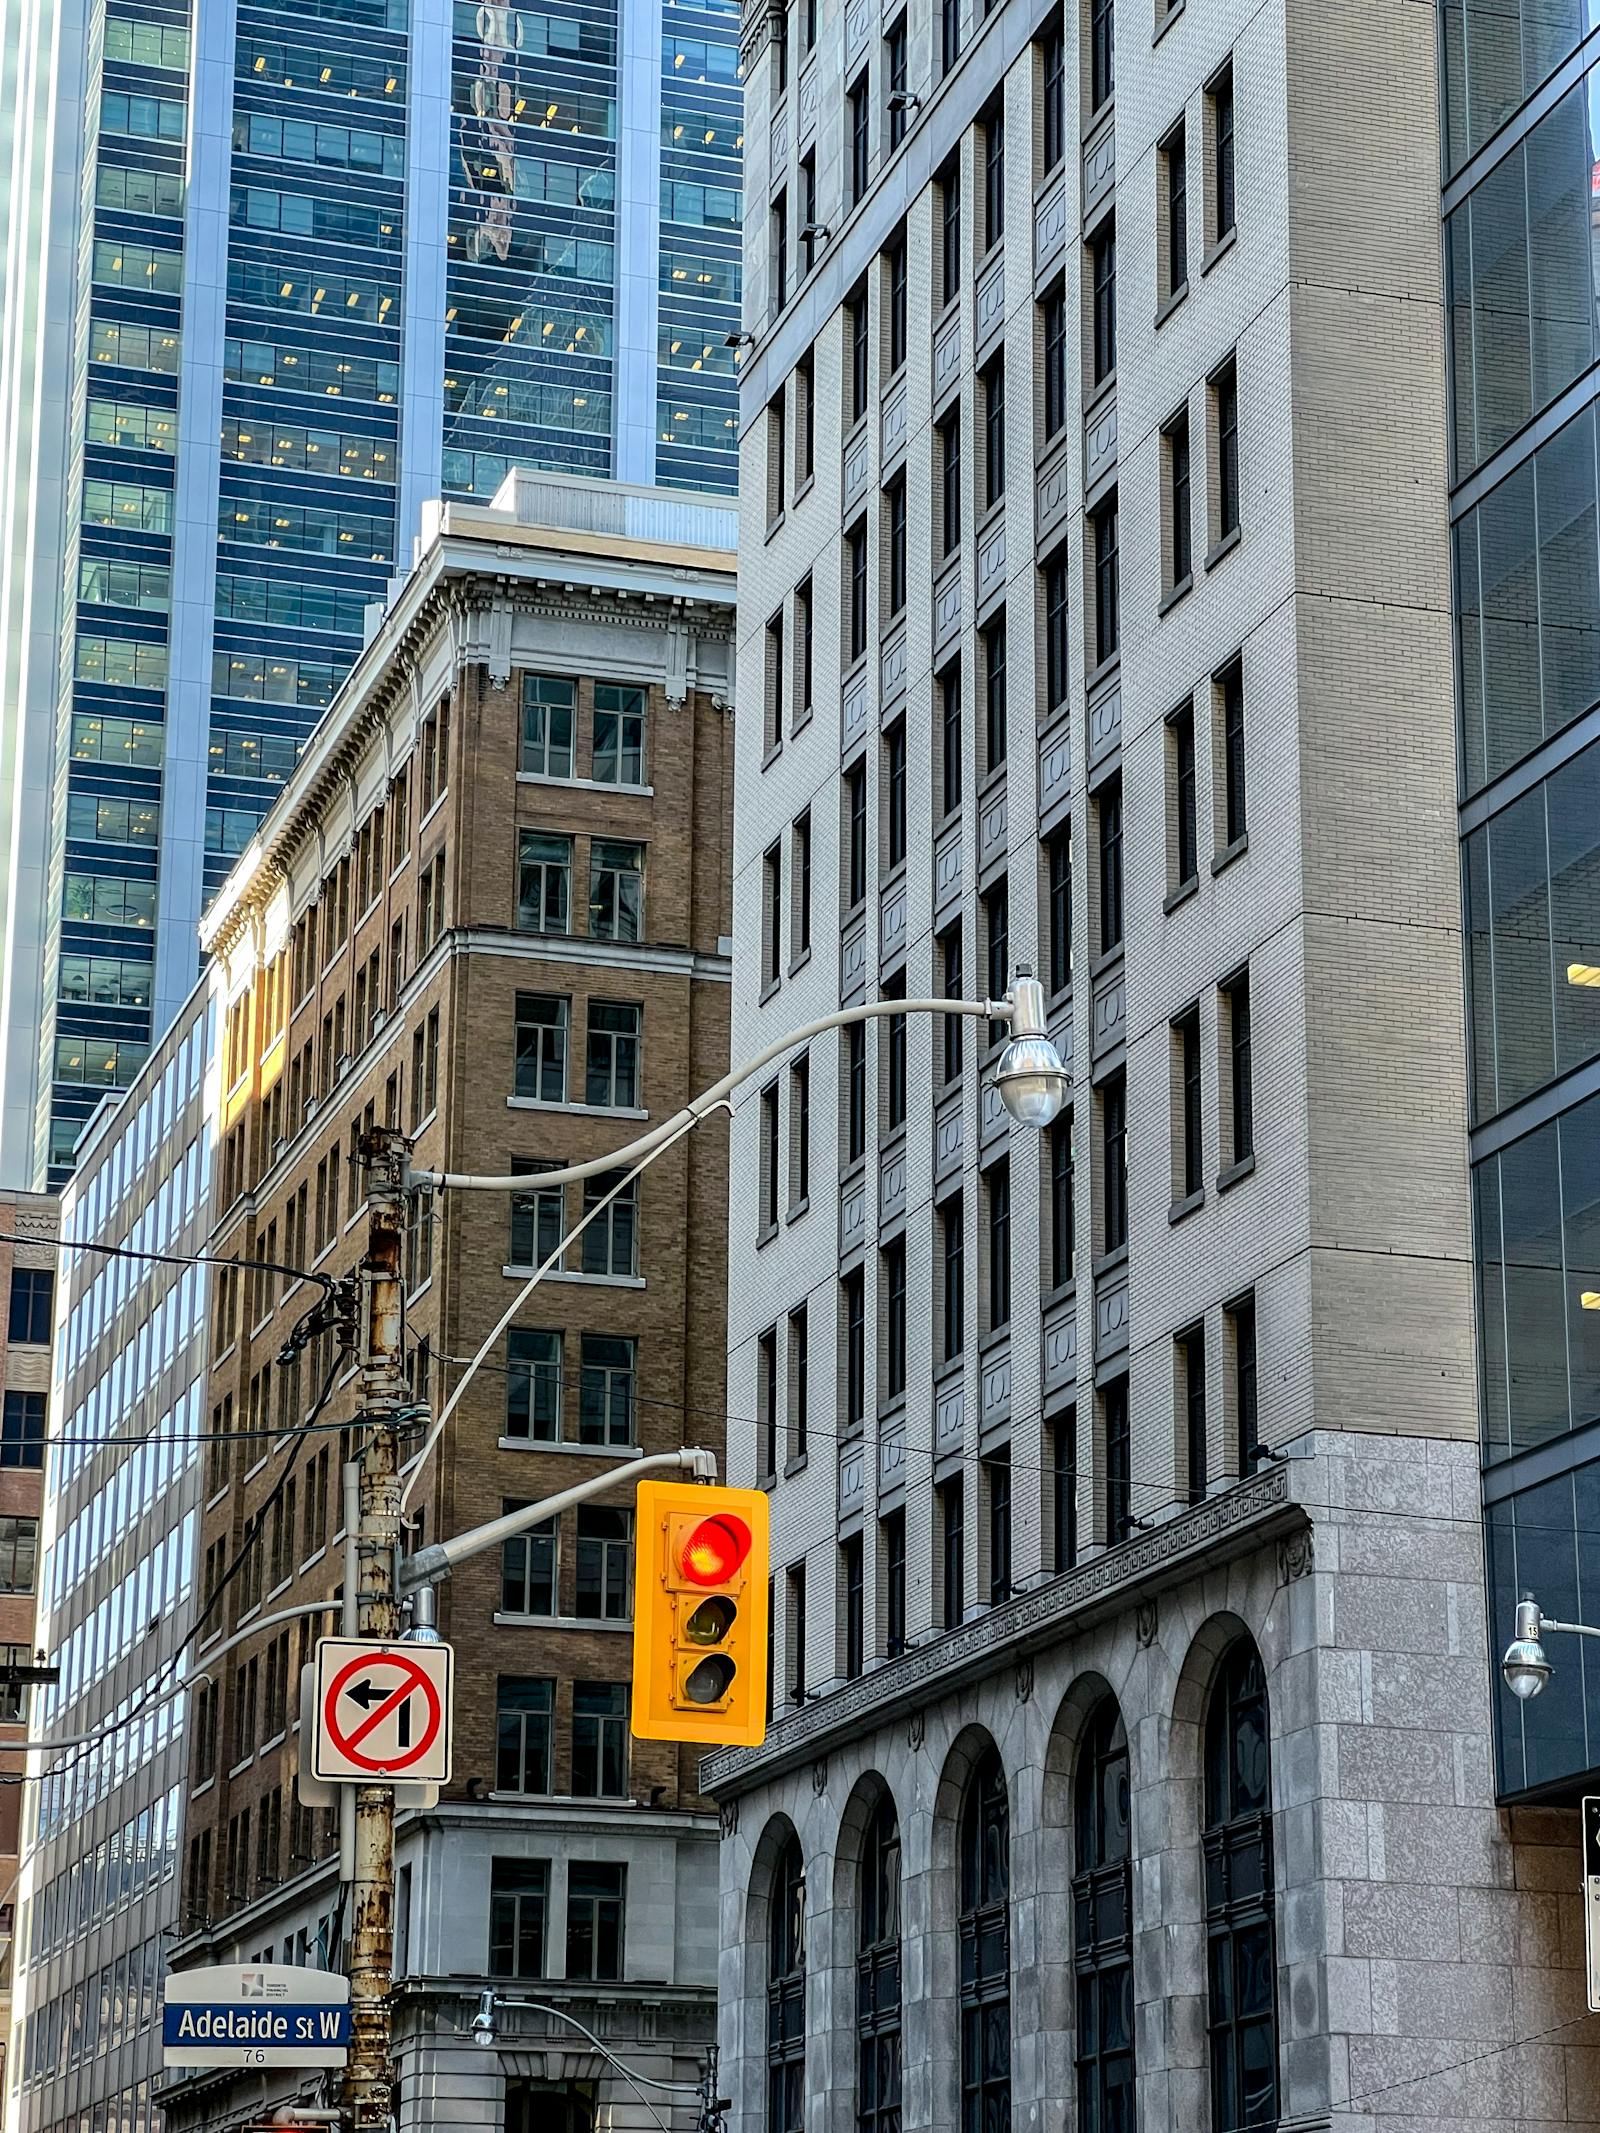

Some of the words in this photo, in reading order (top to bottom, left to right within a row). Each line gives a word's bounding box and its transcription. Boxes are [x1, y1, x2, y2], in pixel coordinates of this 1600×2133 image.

[178, 2009, 288, 2039] Adelaide
[295, 2016, 315, 2039] St
[319, 2011, 341, 2039] W
[243, 2050, 265, 2063] 76
